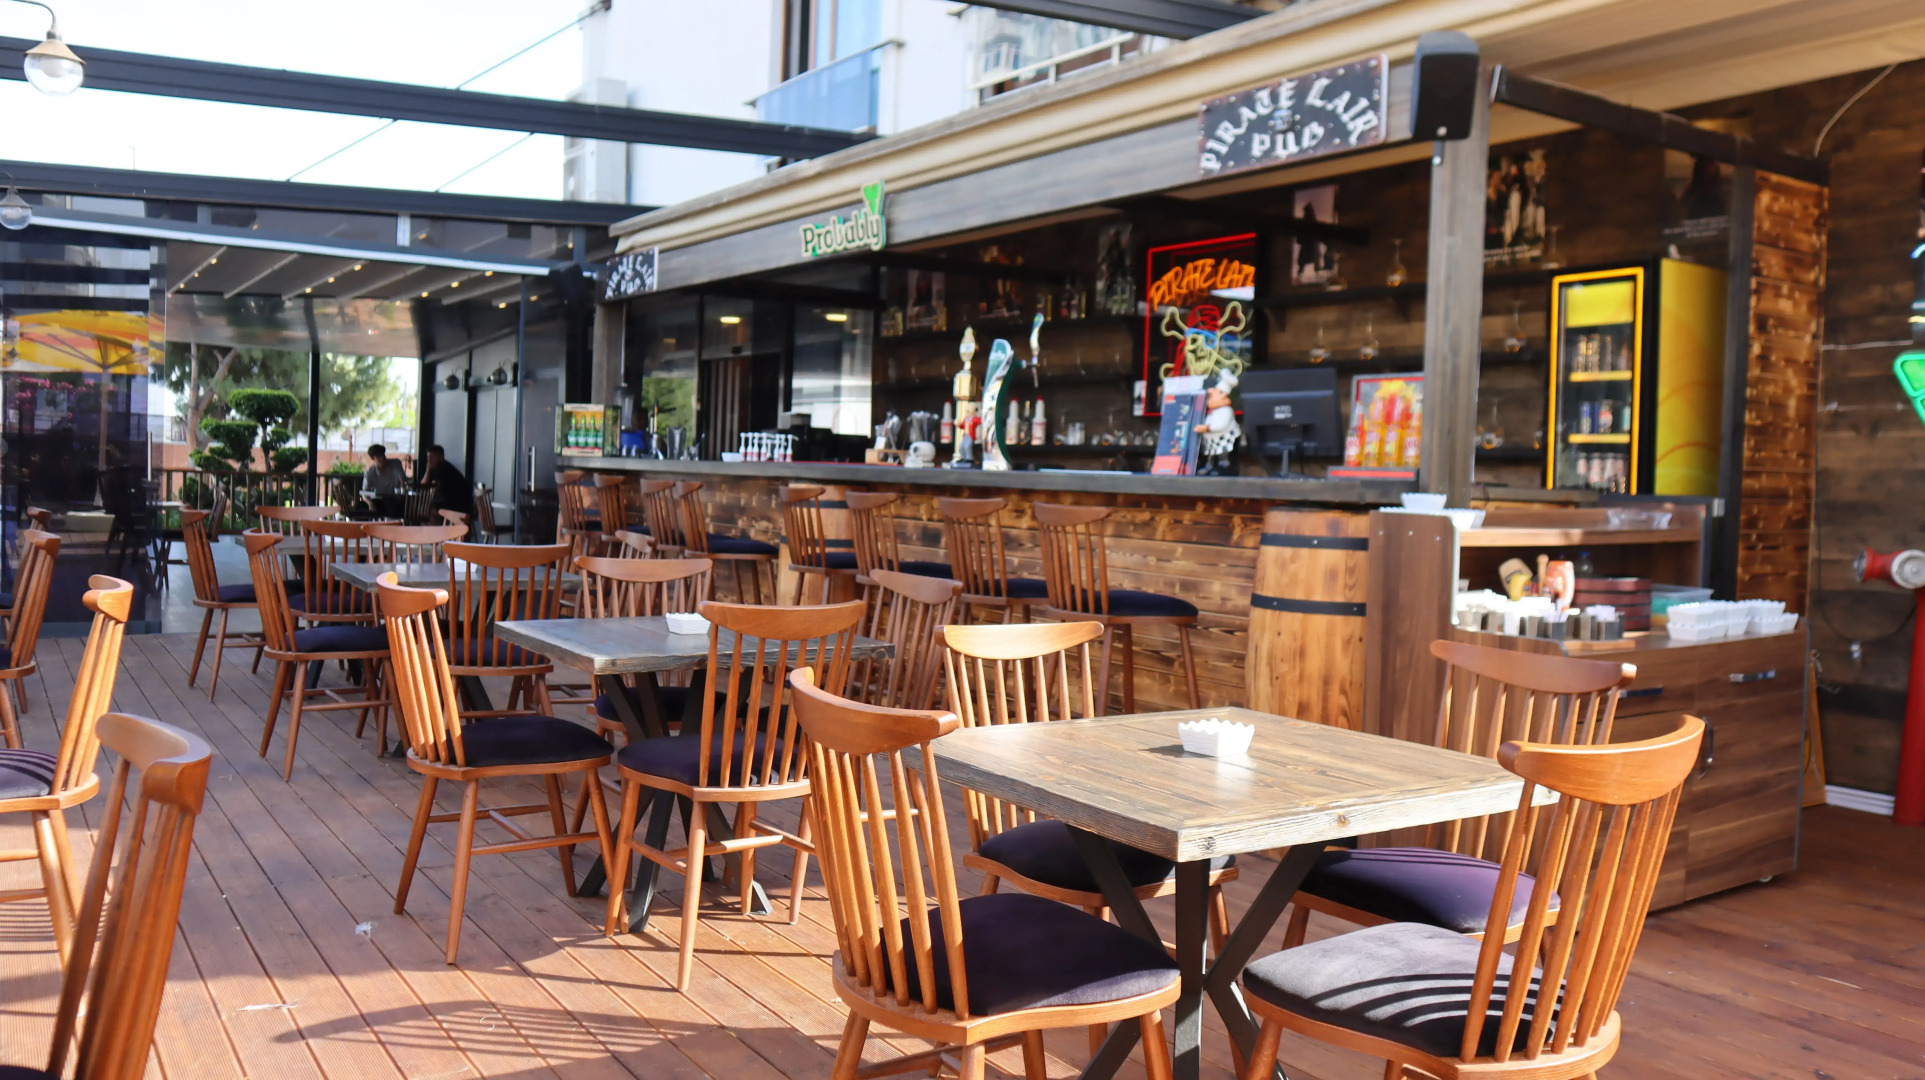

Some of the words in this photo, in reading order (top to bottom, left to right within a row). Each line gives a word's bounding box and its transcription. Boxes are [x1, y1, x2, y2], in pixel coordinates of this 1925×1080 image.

[1200, 79, 1299, 173] PIRATE
[1305, 77, 1379, 147] LAIR
[1251, 121, 1325, 159] PUB
[801, 209, 881, 255] Probably
[1150, 257, 1216, 312] PIRATE
